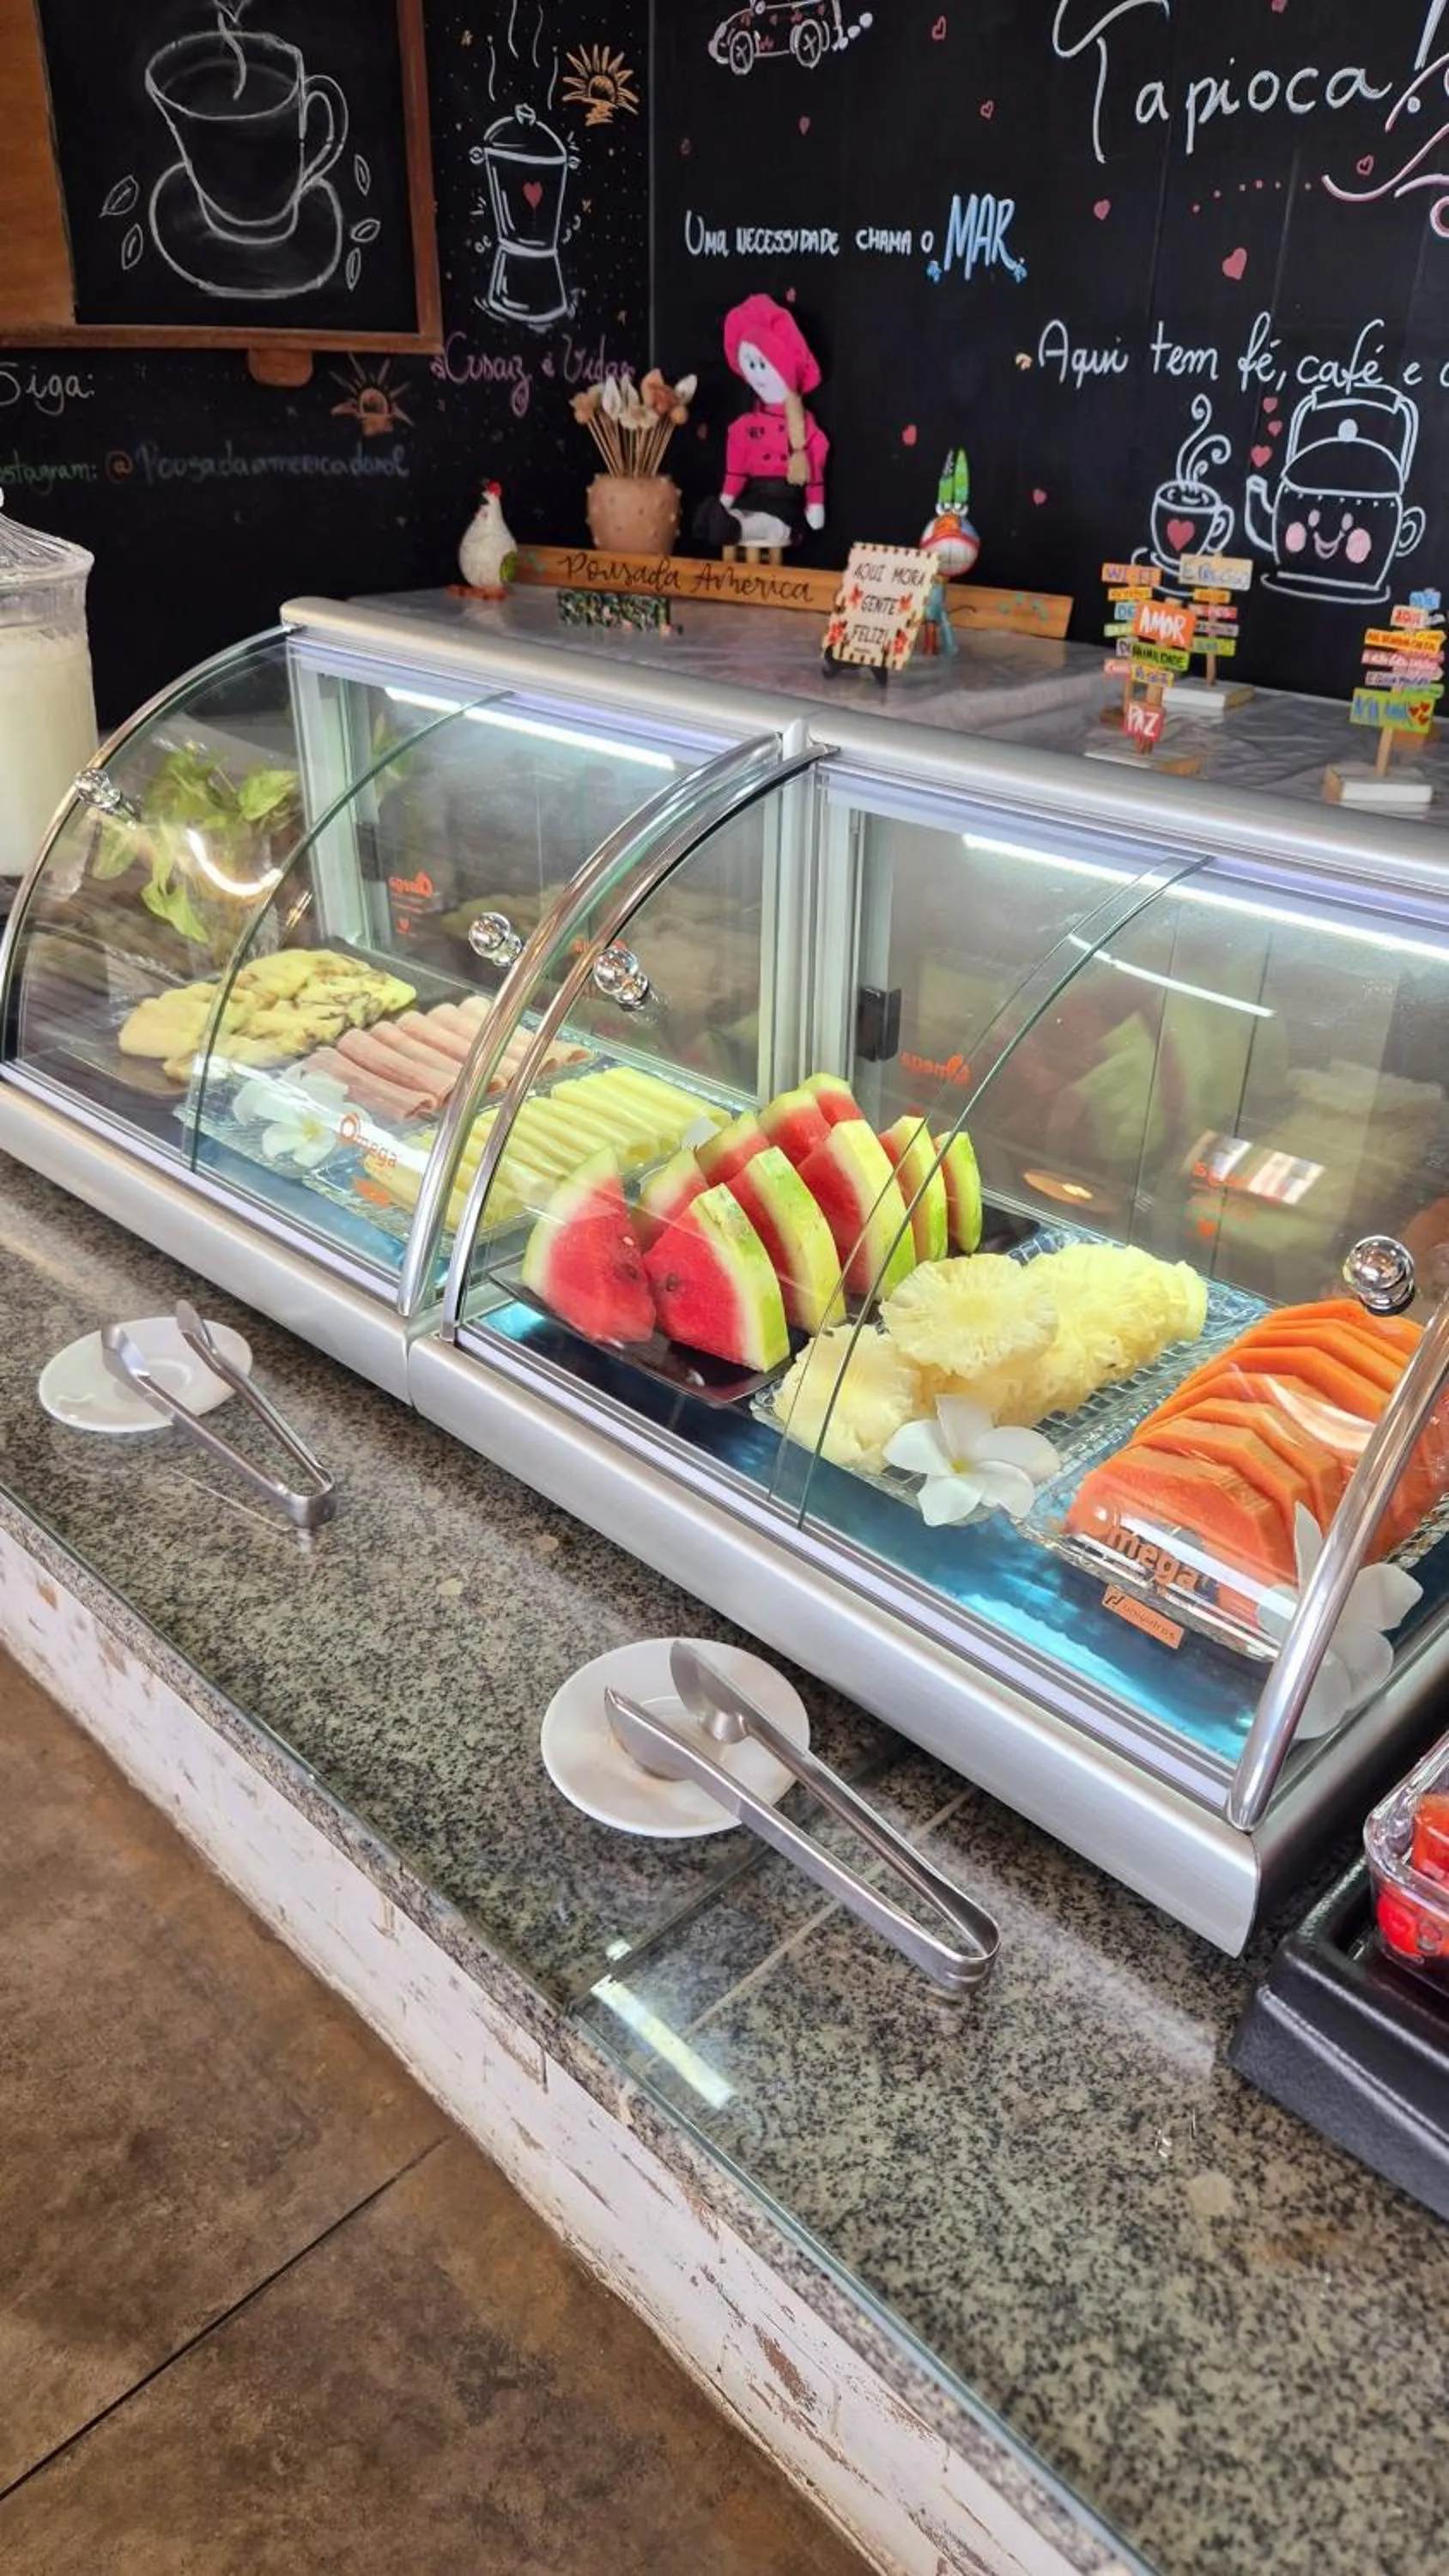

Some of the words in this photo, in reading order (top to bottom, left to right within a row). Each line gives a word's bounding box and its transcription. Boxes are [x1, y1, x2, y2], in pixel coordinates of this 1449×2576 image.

[855, 226, 912, 255] CHAMA
[920, 229, 934, 253] O
[1038, 319, 1129, 389] Aqui
[1150, 320, 1219, 381] tem
[1237, 311, 1287, 392] fé,
[1296, 319, 1385, 395] café
[1403, 361, 1422, 386] e
[560, 551, 682, 592] Pousada
[853, 562, 886, 583] AQUI
[892, 567, 926, 586] MORA
[861, 593, 899, 616] GENTE
[1138, 605, 1187, 647] AMOR
[1126, 704, 1160, 738] PAZ
[339, 1113, 398, 1168] Omega
